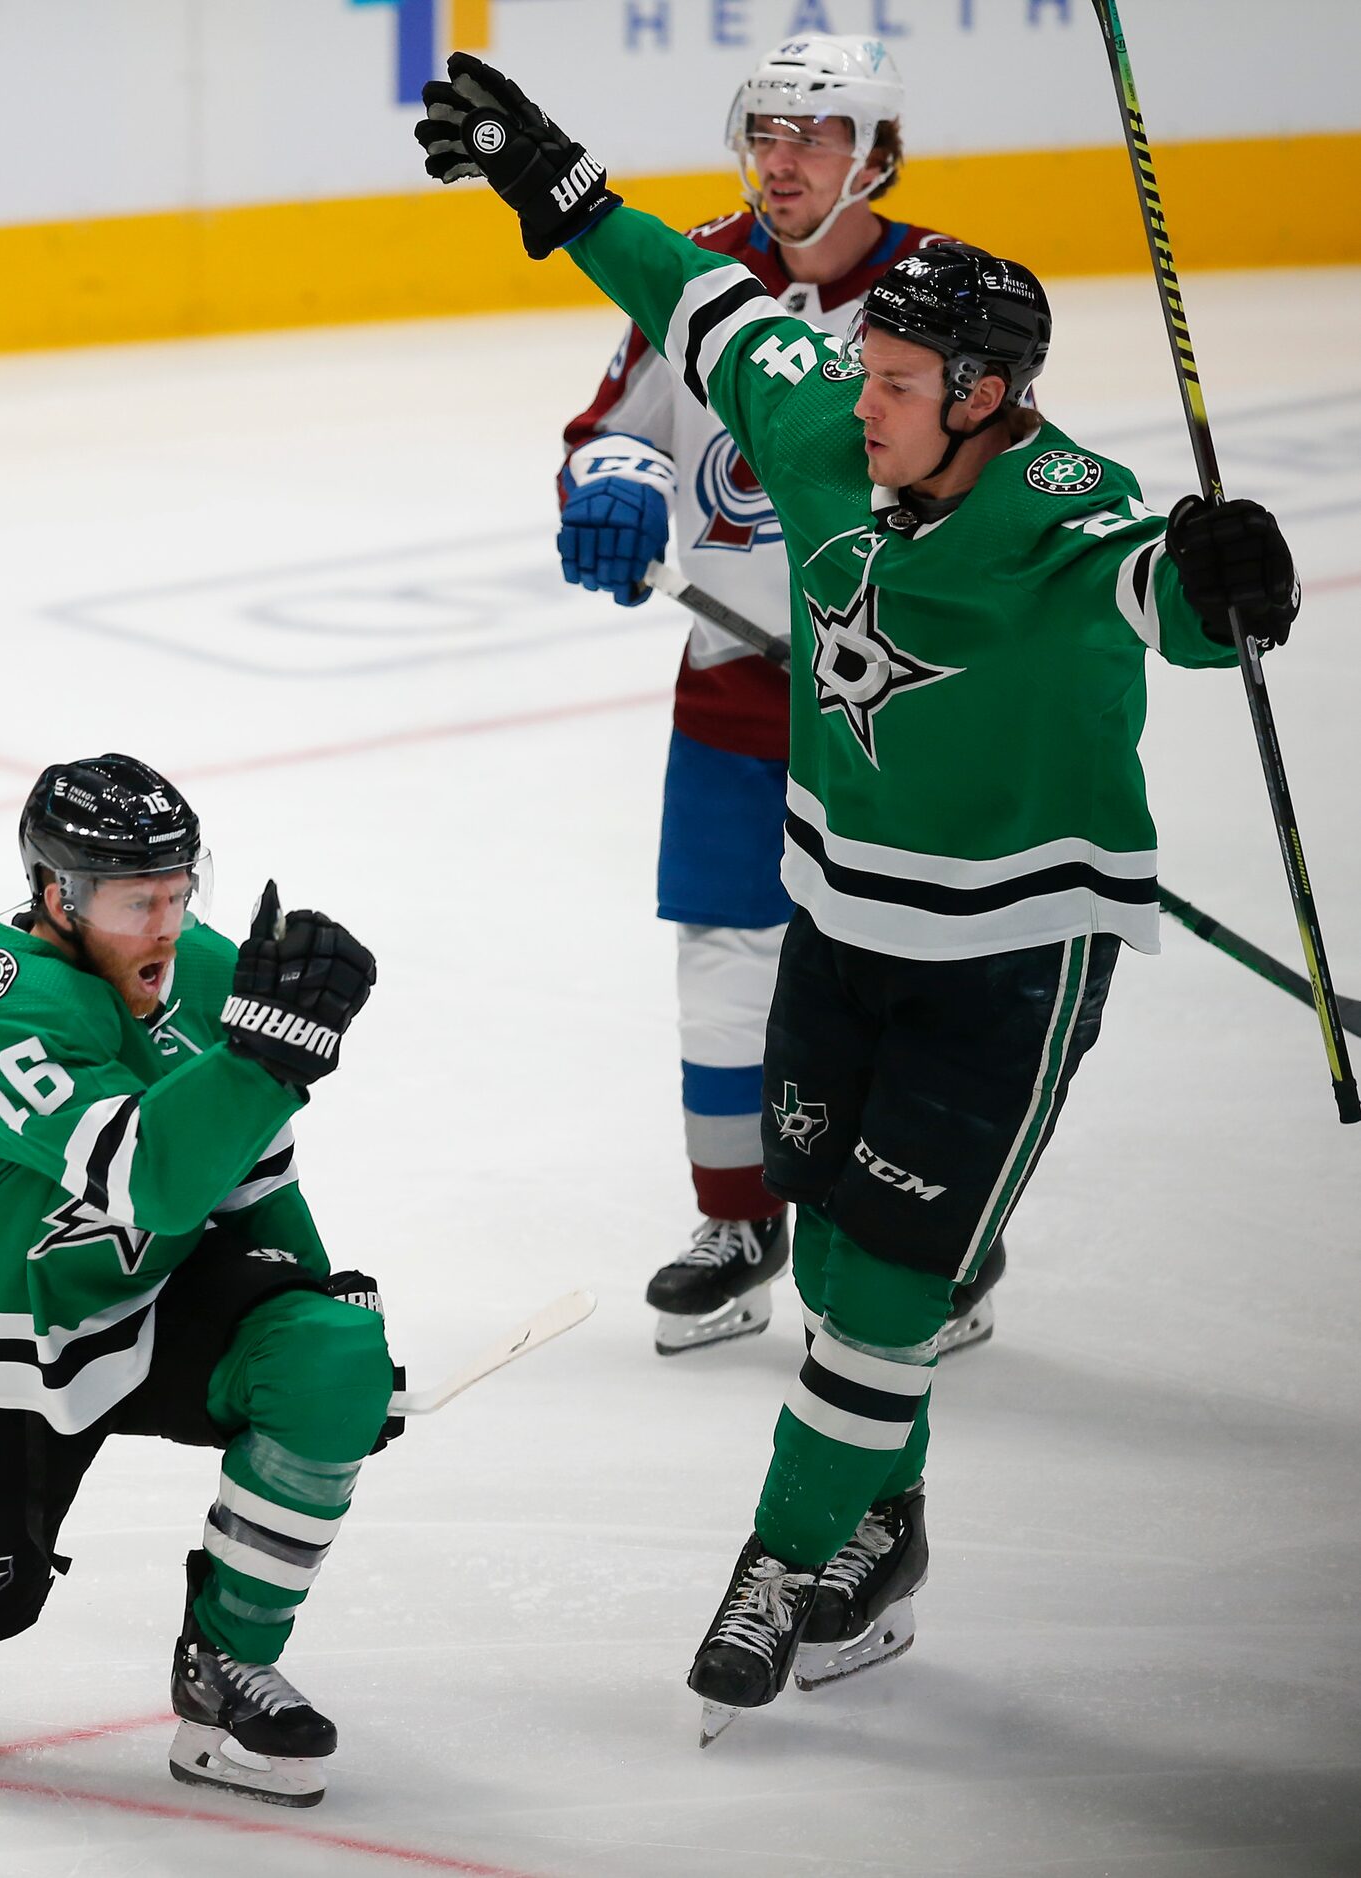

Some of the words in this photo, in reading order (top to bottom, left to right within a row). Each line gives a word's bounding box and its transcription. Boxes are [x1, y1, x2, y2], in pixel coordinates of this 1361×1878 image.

[894, 256, 932, 279] 24
[873, 286, 906, 306] CCM
[586, 456, 676, 482] CC
[66, 793, 99, 814] TRANSFER
[69, 785, 97, 803] ENERGY
[140, 790, 172, 815] 16
[853, 1136, 948, 1201] CCM
